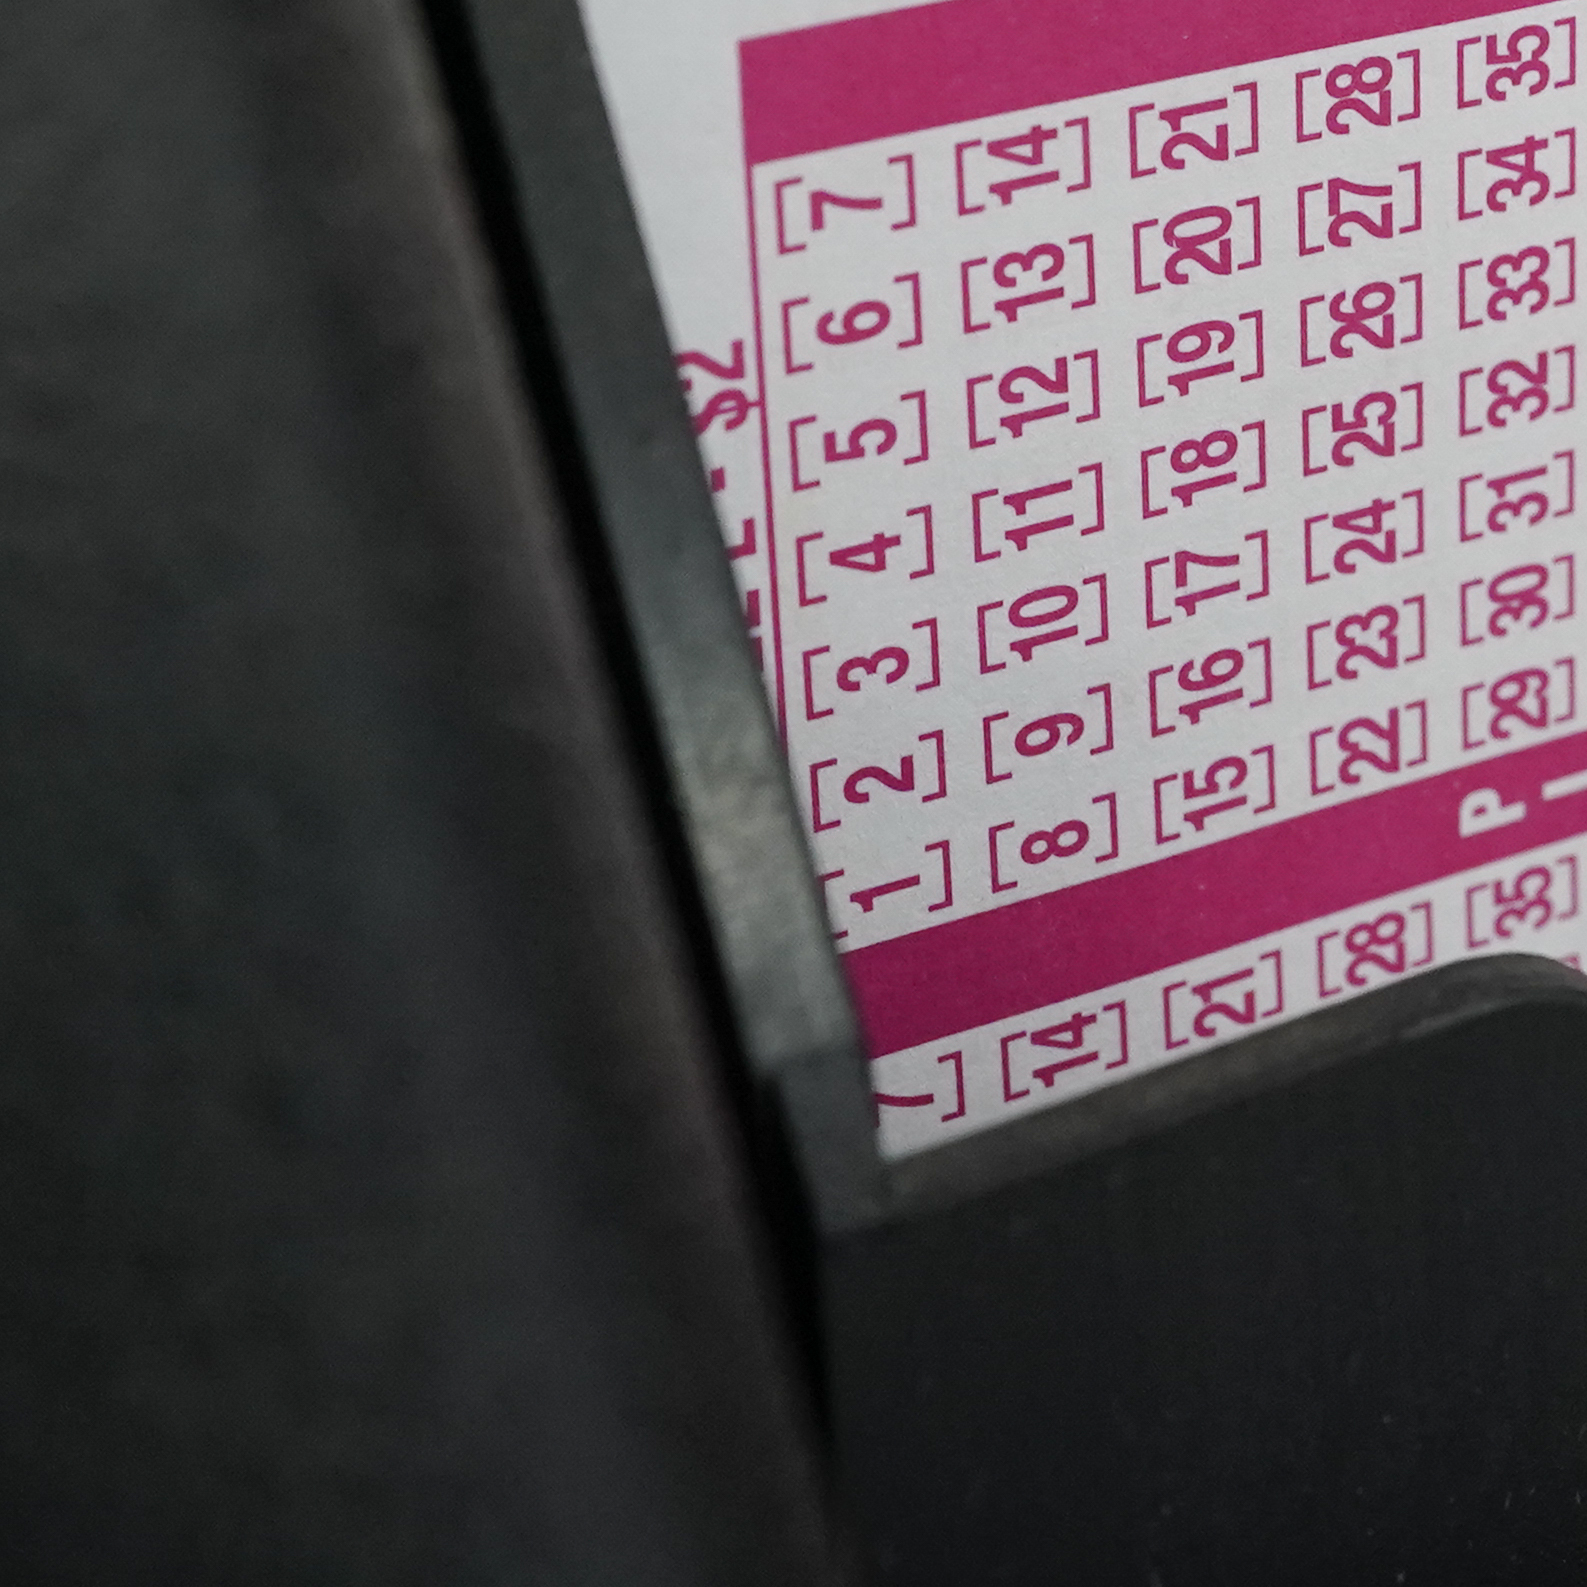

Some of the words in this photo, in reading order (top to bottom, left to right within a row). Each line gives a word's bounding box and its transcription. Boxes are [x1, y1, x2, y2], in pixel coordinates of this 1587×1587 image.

[1325, 56, 1392, 135] 28
[1486, 25, 1550, 101] 35
[987, 125, 1059, 205] 14
[1159, 98, 1229, 170] 21
[809, 190, 882, 231] 7
[1486, 136, 1550, 212] 34
[1163, 206, 1232, 285] 20
[1328, 178, 1393, 247] 27
[993, 243, 1065, 322] 13
[1487, 246, 1549, 321] 33
[816, 301, 890, 345] 6
[1329, 282, 1395, 358] 26
[1167, 320, 1235, 396] 19
[1487, 352, 1549, 427] 32
[998, 357, 1069, 438] 12
[1331, 391, 1396, 466] 25
[823, 419, 897, 462] 5
[1170, 430, 1238, 507] 18
[1003, 480, 1074, 551] 11
[1332, 499, 1396, 574] 24
[1487, 467, 1549, 532] 31
[829, 533, 901, 572] 4
[1174, 551, 1240, 616] 17
[1008, 585, 1079, 661] 10
[1488, 564, 1549, 636] 30
[837, 647, 909, 692] 3
[1335, 605, 1399, 679] 23
[1178, 649, 1244, 724] 16
[1489, 668, 1549, 739] 29
[1014, 713, 1084, 757] 9
[1338, 708, 1400, 785] 22
[843, 756, 914, 804] 2
[1182, 756, 1247, 831] 15
[1020, 820, 1089, 864] 8
[849, 875, 920, 912] 1
[1493, 866, 1552, 938] 35
[1345, 912, 1406, 986] 28
[1192, 968, 1256, 1037] 21
[1030, 1013, 1099, 1087] 14
